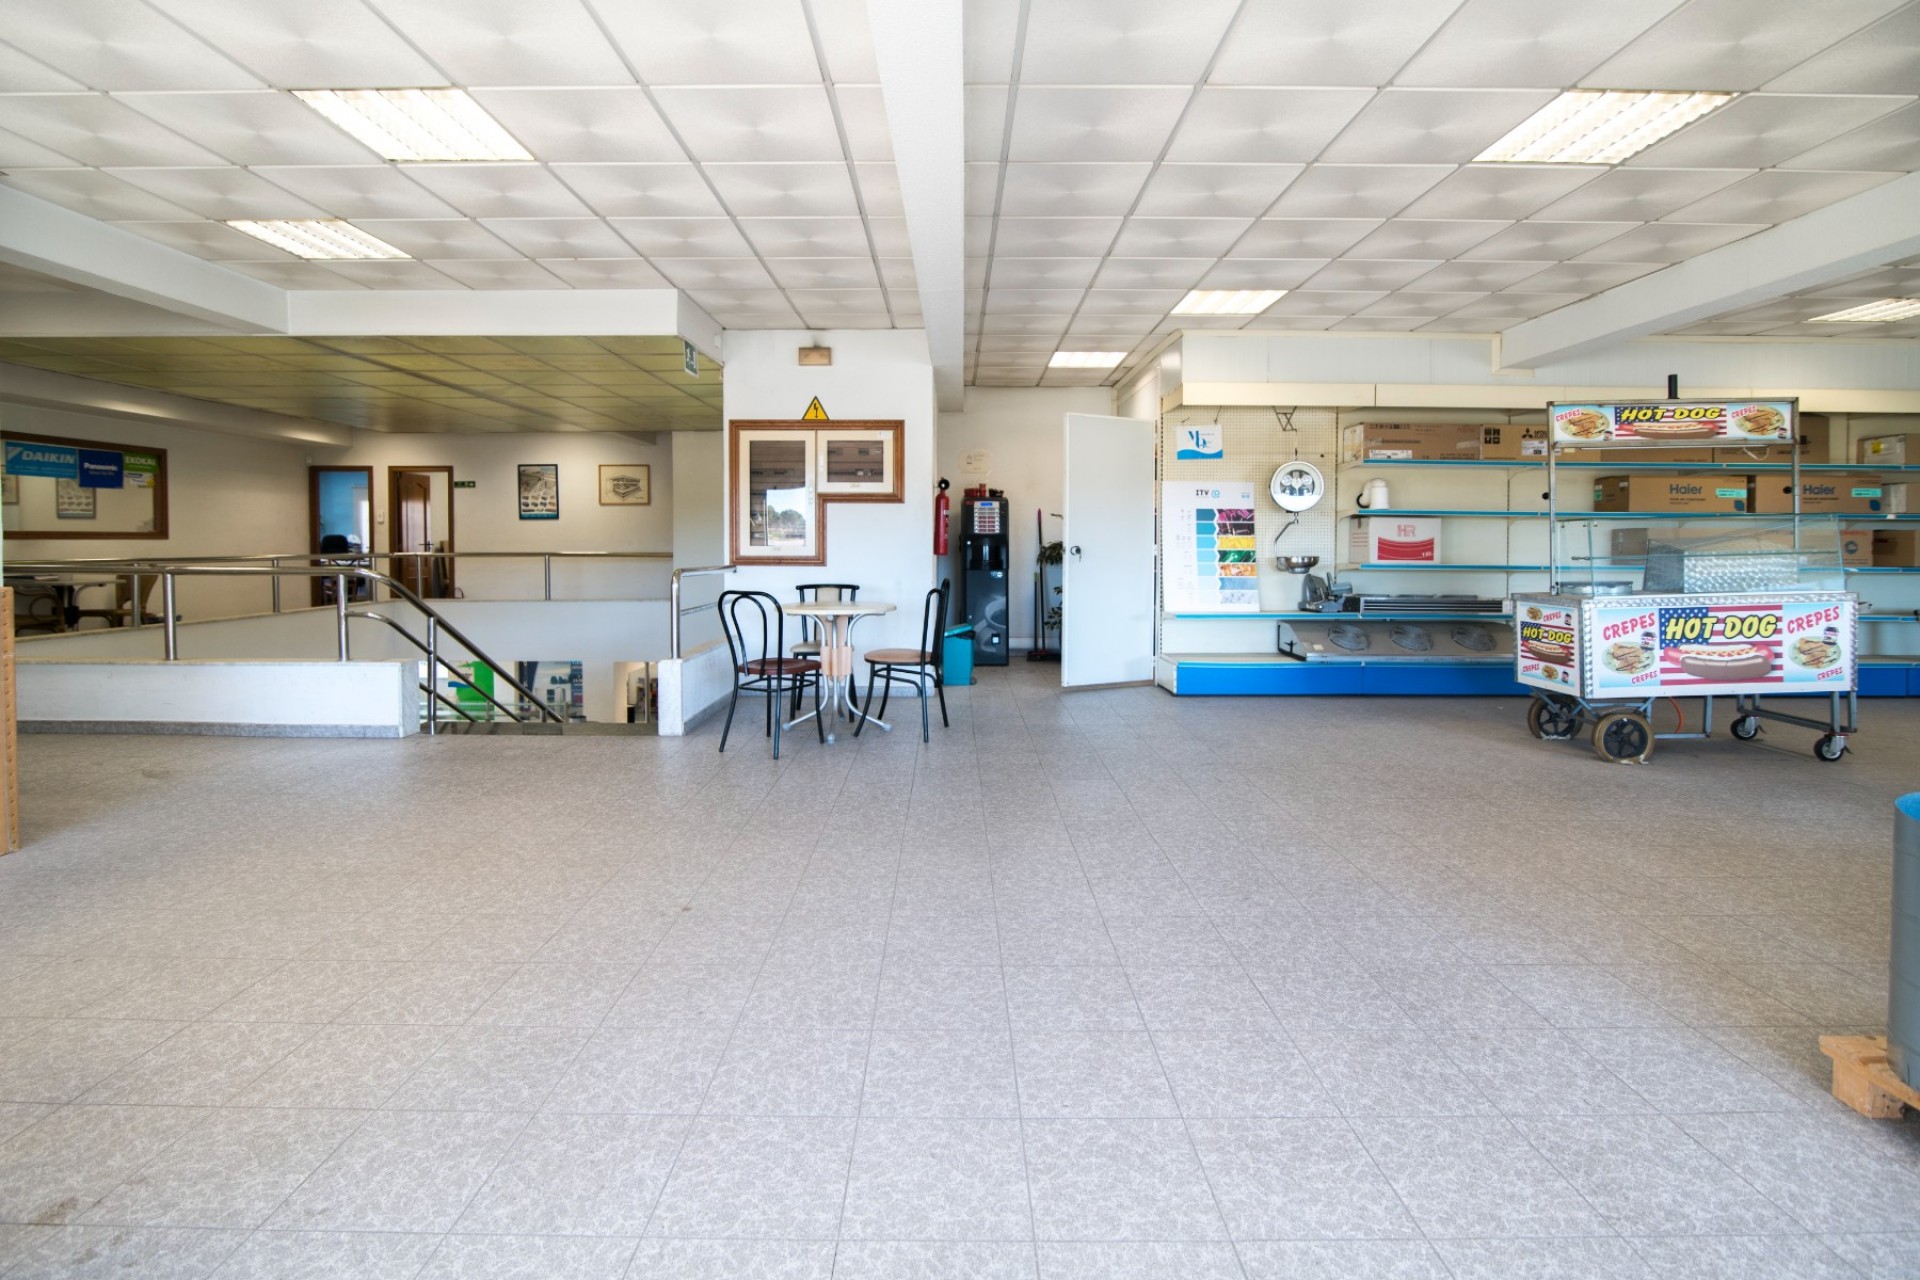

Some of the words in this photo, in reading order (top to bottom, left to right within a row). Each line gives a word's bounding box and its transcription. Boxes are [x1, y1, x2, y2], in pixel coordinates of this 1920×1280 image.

[1555, 409, 1581, 421] CREPES
[1620, 408, 1667, 421] HOT
[1673, 407, 1721, 420] DOG
[1731, 405, 1757, 419] CREPES
[22, 450, 75, 464] DAIKIN
[1669, 484, 1703, 495] Haier
[1803, 484, 1836, 495] Haier
[1543, 611, 1562, 622] CREPES
[1787, 605, 1840, 634] CREPES
[1603, 612, 1656, 641] CREPES
[1665, 616, 1719, 641] HOT
[1723, 614, 1778, 639] DOG
[1522, 626, 1545, 640] HOT
[1547, 629, 1573, 645] DOG
[1522, 663, 1540, 673] CREPES
[1817, 666, 1842, 681] CREPES
[1631, 670, 1658, 685] CREPES
